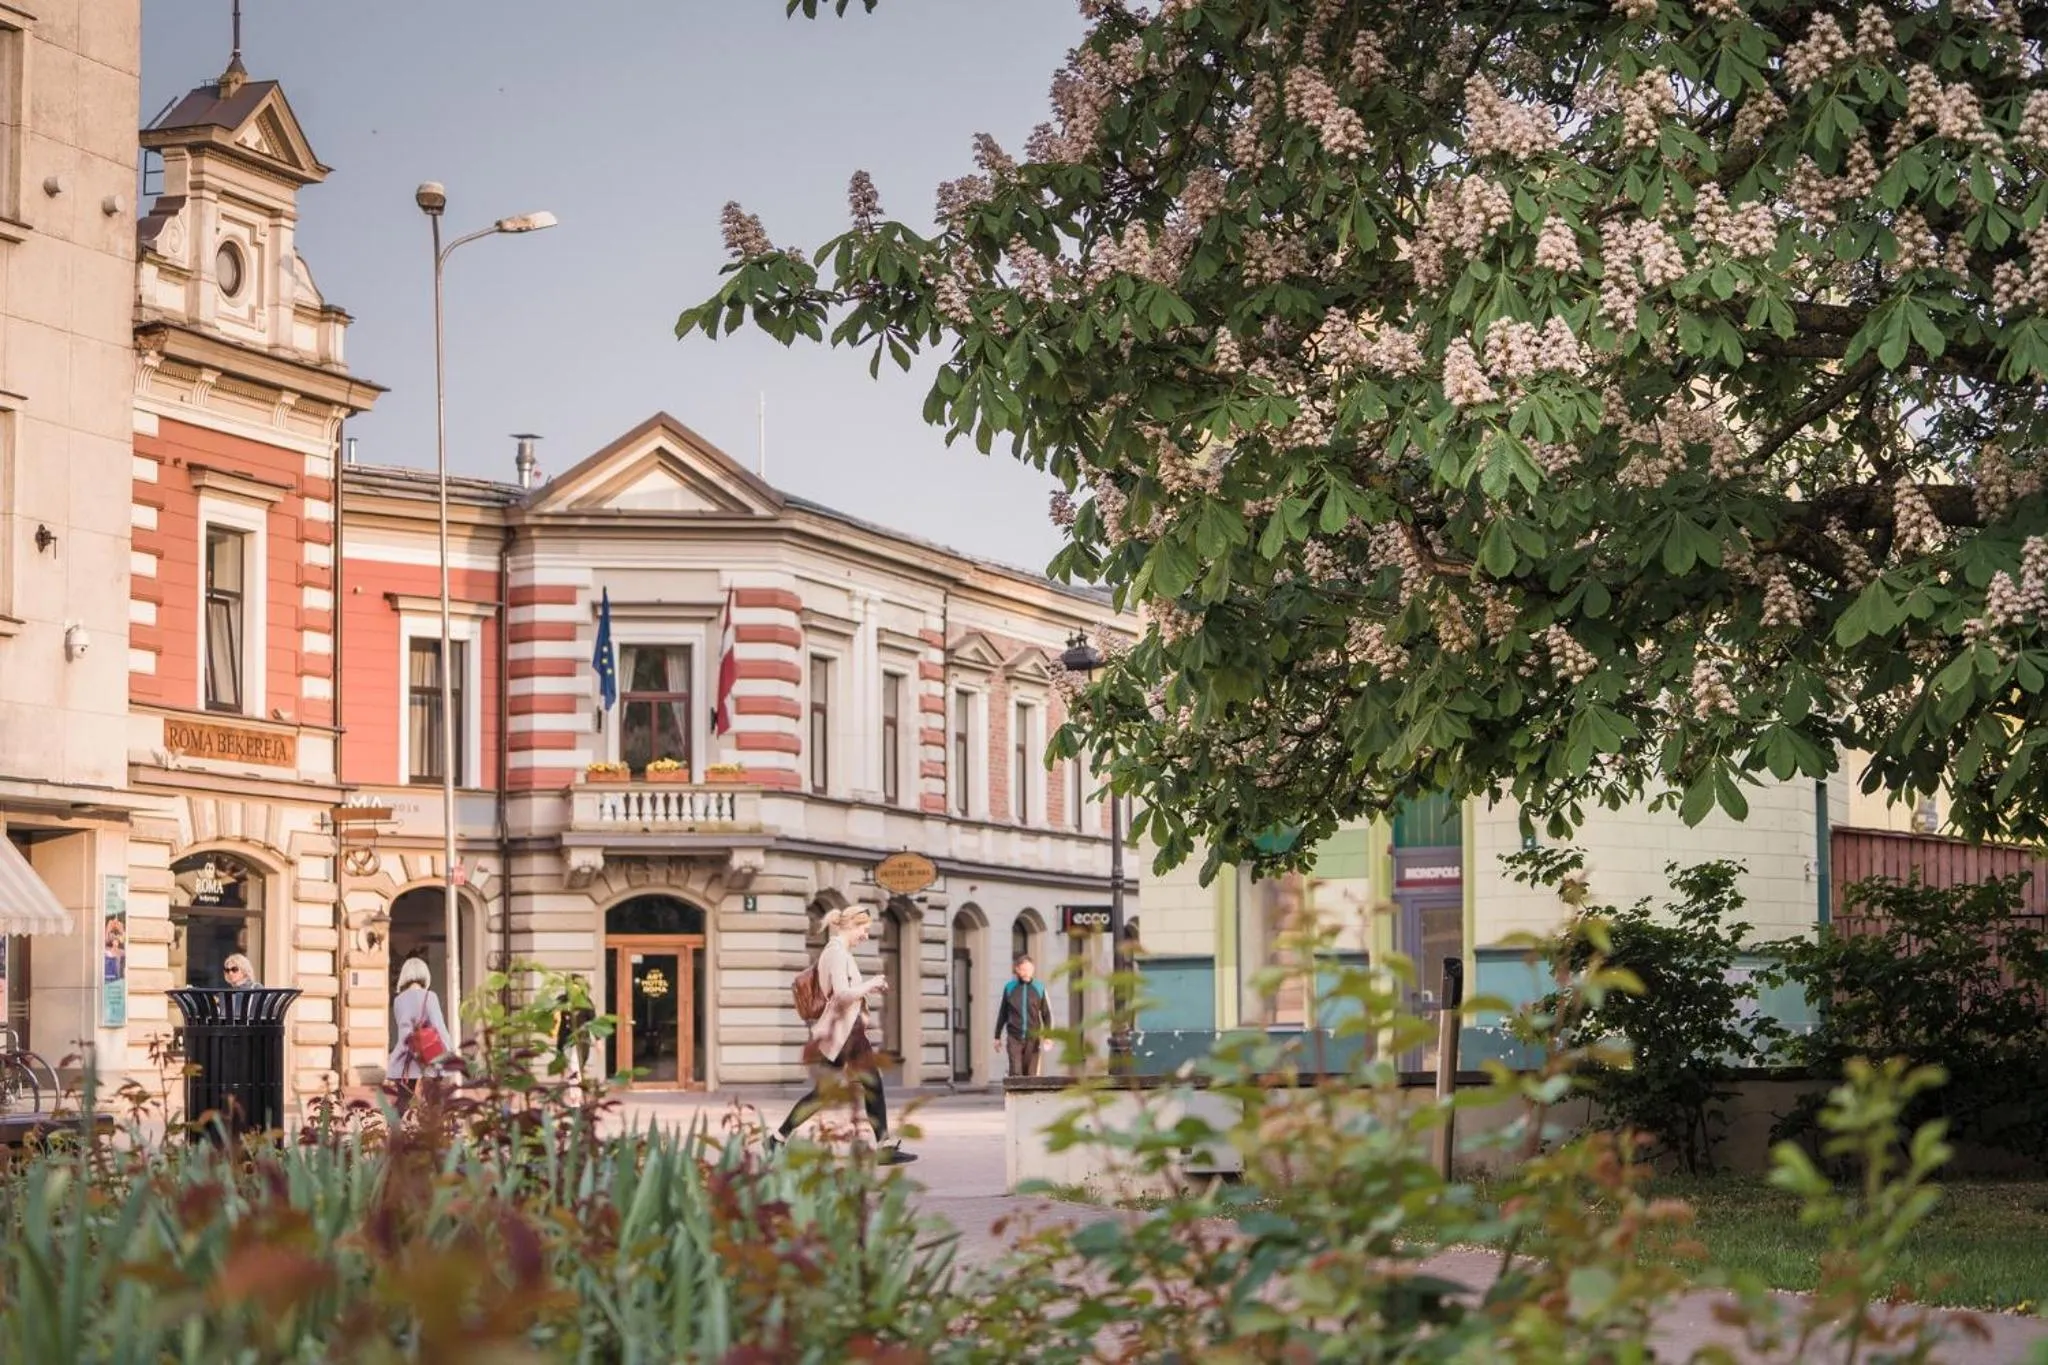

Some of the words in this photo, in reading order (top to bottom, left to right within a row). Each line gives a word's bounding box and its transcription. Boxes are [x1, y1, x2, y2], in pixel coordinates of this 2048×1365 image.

[169, 726, 213, 752] ROMA
[898, 861, 912, 869] ART
[195, 878, 224, 894] ROMA
[1073, 912, 1110, 925] ecco
[647, 972, 664, 980] ART
